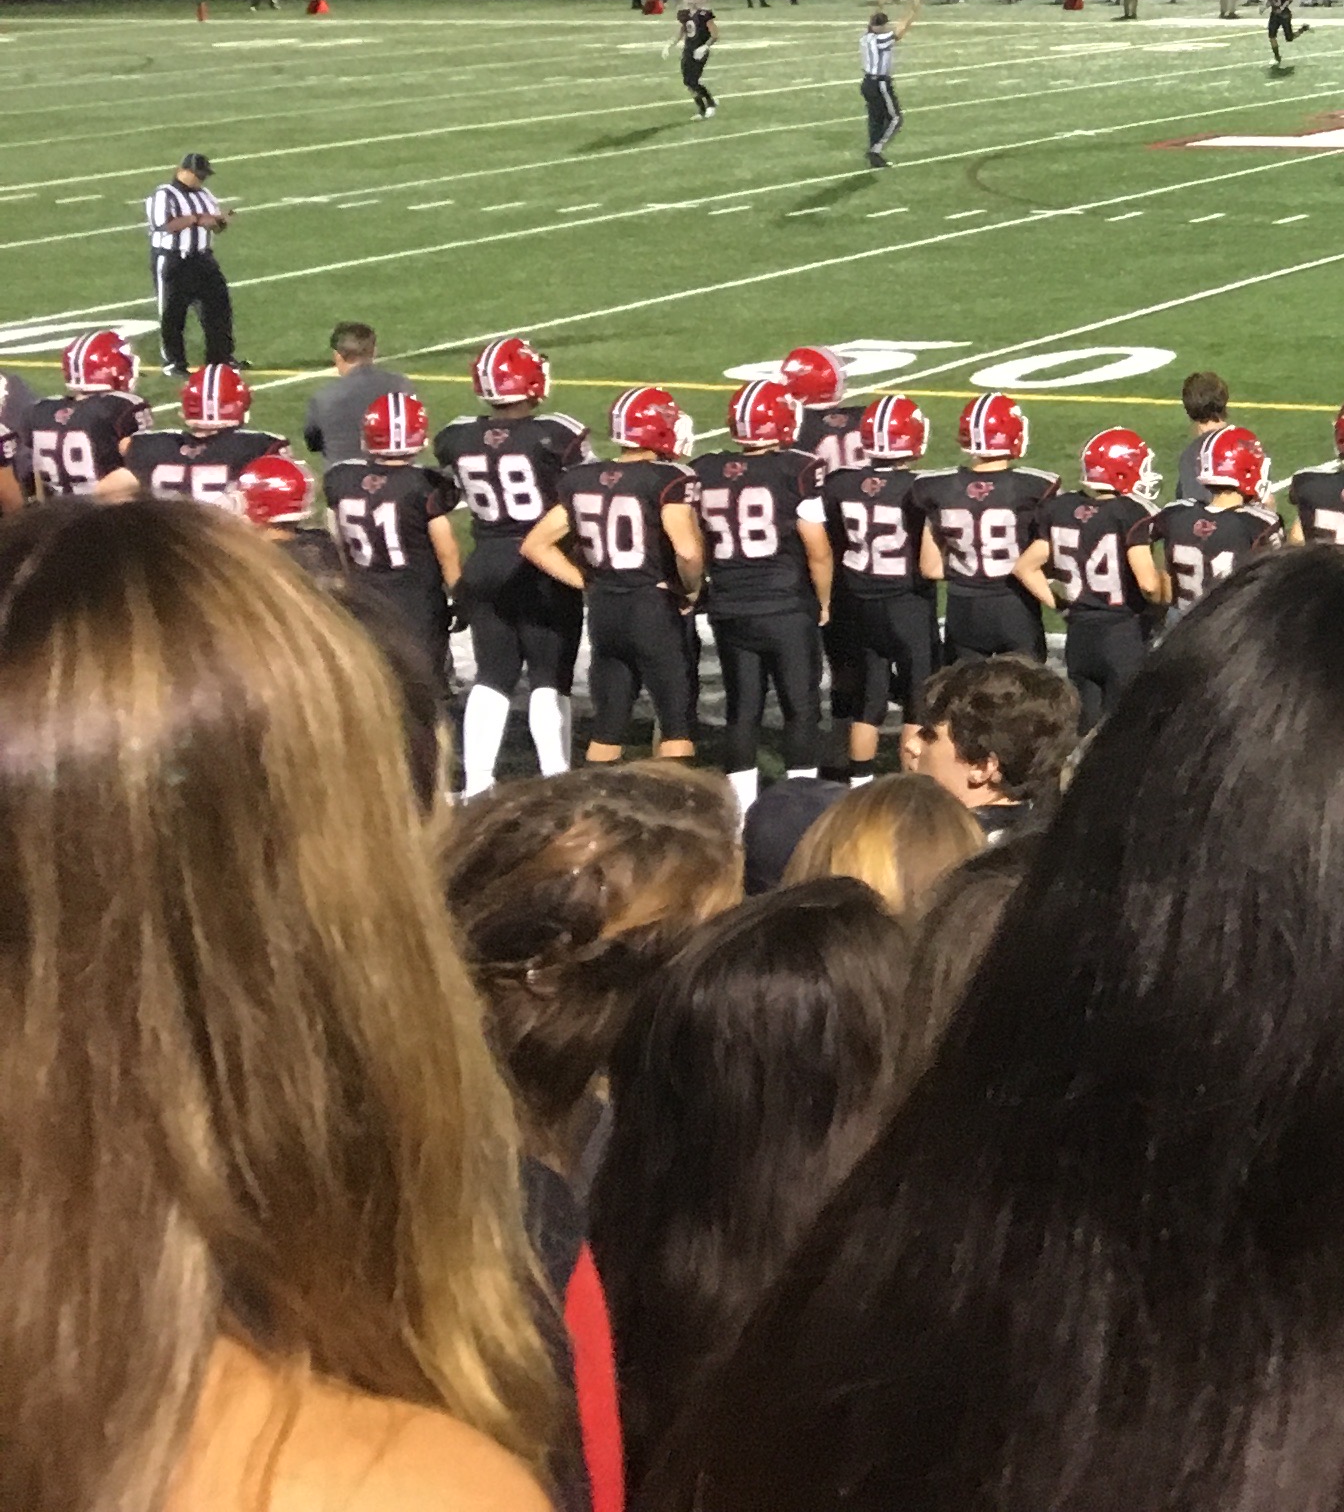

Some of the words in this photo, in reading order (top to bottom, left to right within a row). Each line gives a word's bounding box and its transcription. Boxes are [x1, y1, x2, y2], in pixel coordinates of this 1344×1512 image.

[573, 493, 645, 570] 50
[701, 487, 778, 559] 58
[841, 501, 908, 575] 32
[940, 508, 1019, 577] 38
[1050, 526, 1124, 605] 54
